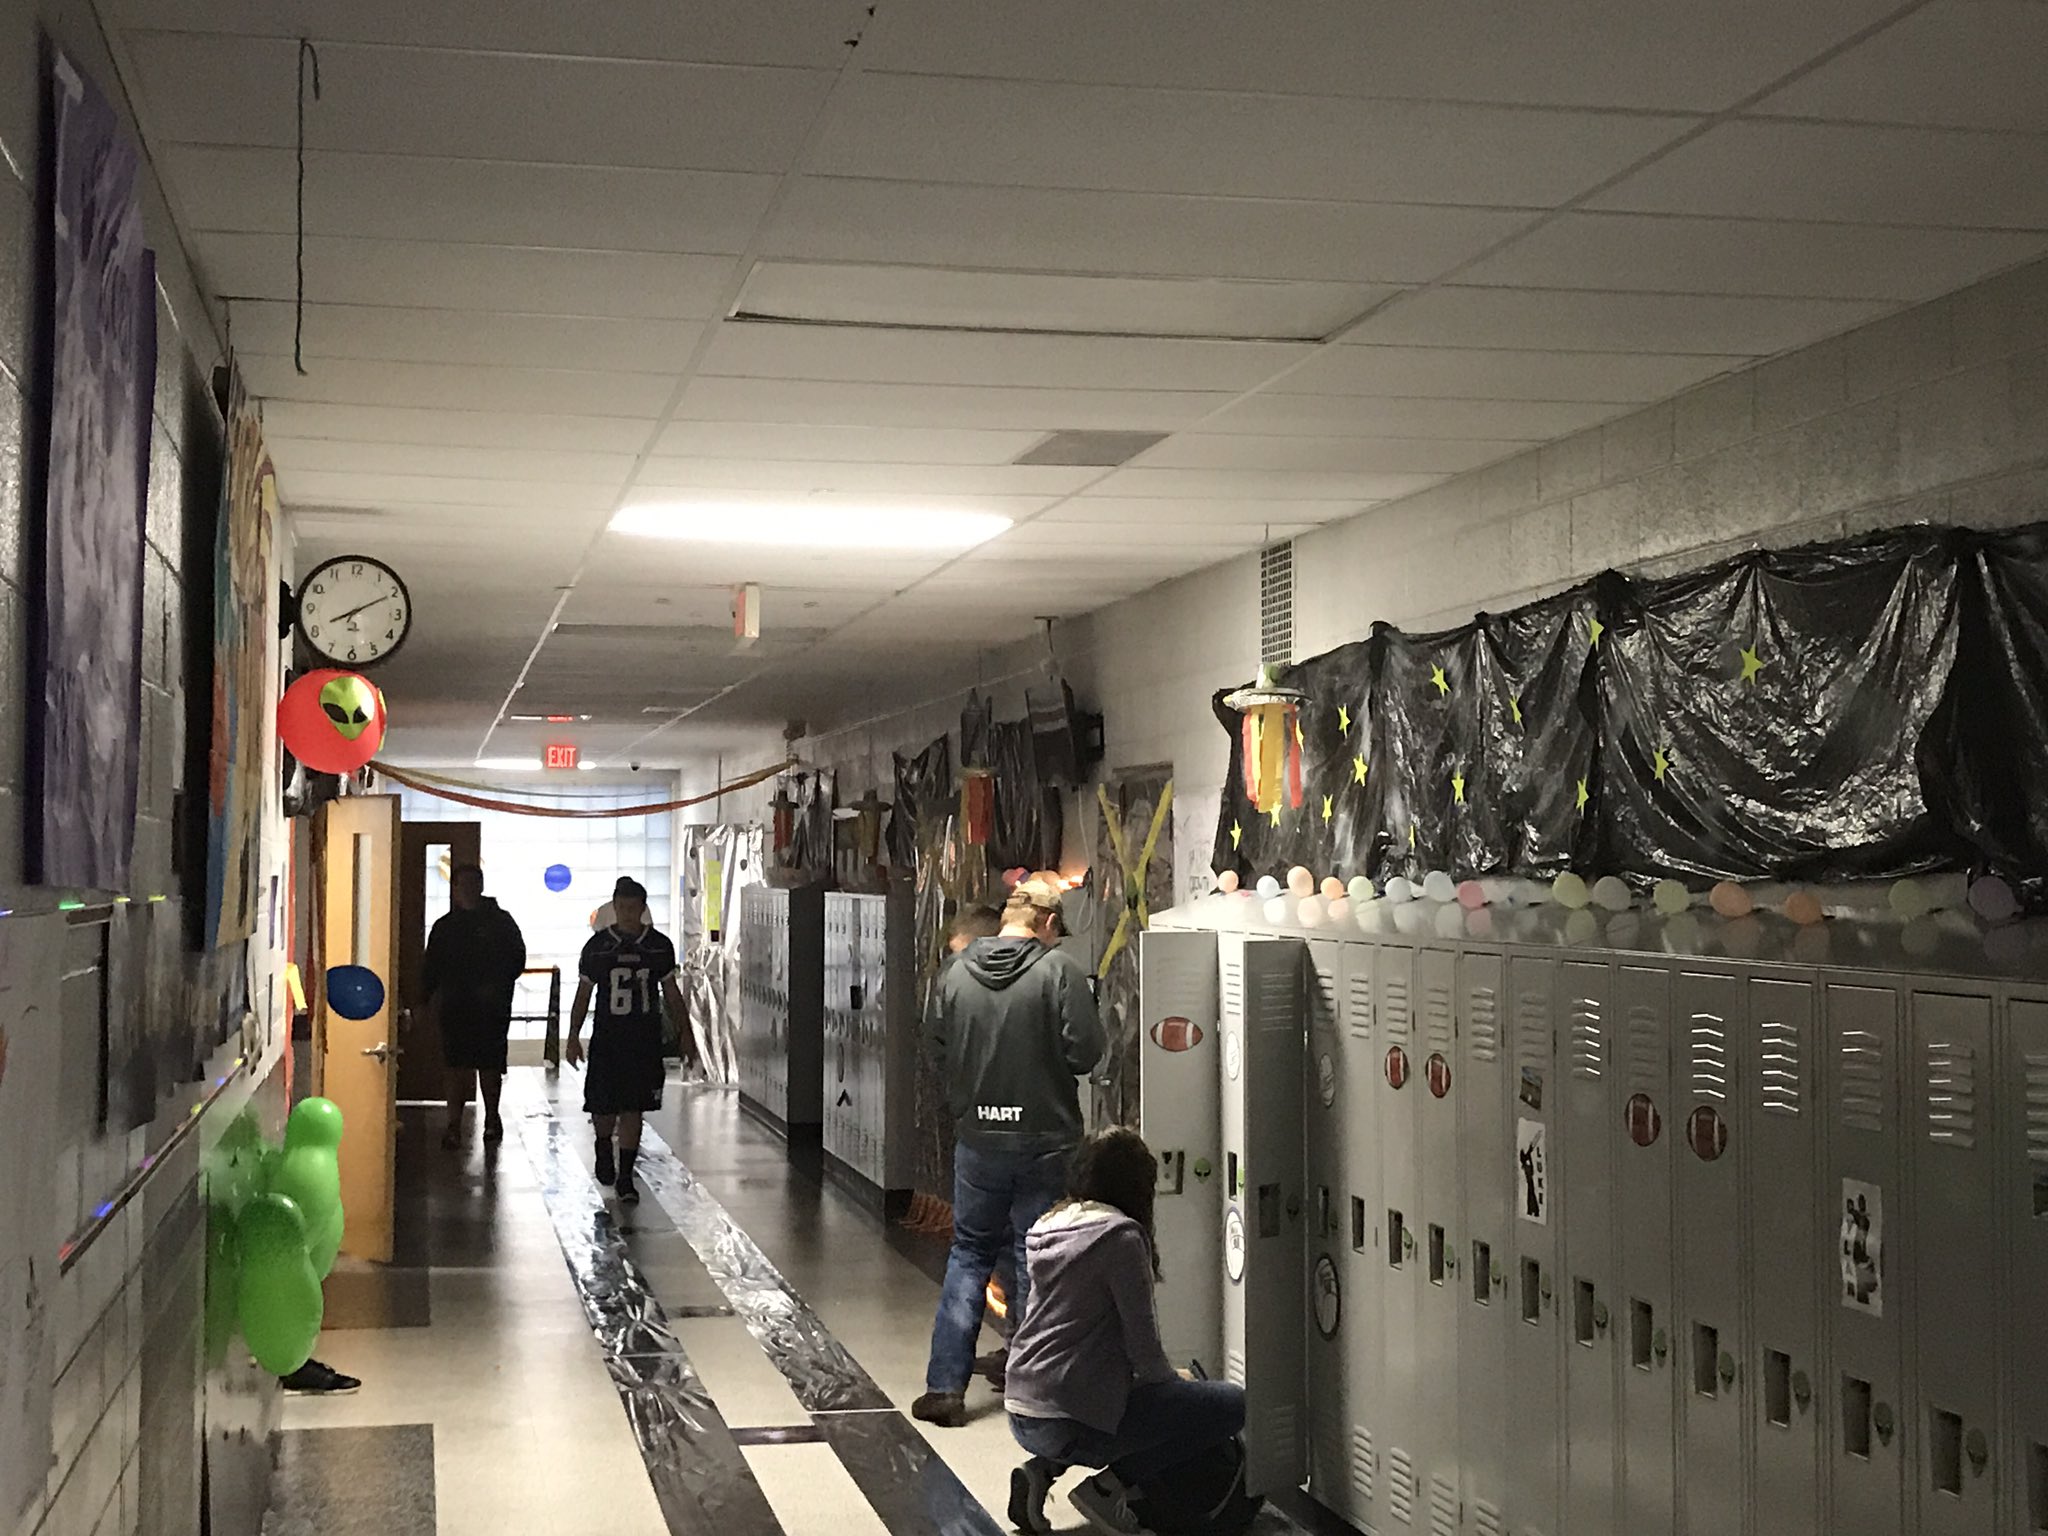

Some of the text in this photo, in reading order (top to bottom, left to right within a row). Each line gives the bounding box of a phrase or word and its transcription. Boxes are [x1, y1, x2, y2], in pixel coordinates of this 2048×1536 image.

[330, 568, 339, 582] 11
[351, 564, 363, 575] 12
[312, 584, 324, 594] 10
[391, 586, 398, 598] 2
[306, 602, 316, 615] 9
[394, 609, 402, 621] 3
[310, 625, 320, 638] 8
[385, 629, 394, 640] 4
[328, 642, 336, 653] 7
[347, 646, 357, 661] 6
[369, 642, 378, 656] 5
[547, 747, 577, 768] EXIT
[610, 967, 650, 1015] 61
[977, 1105, 1023, 1122] HART
